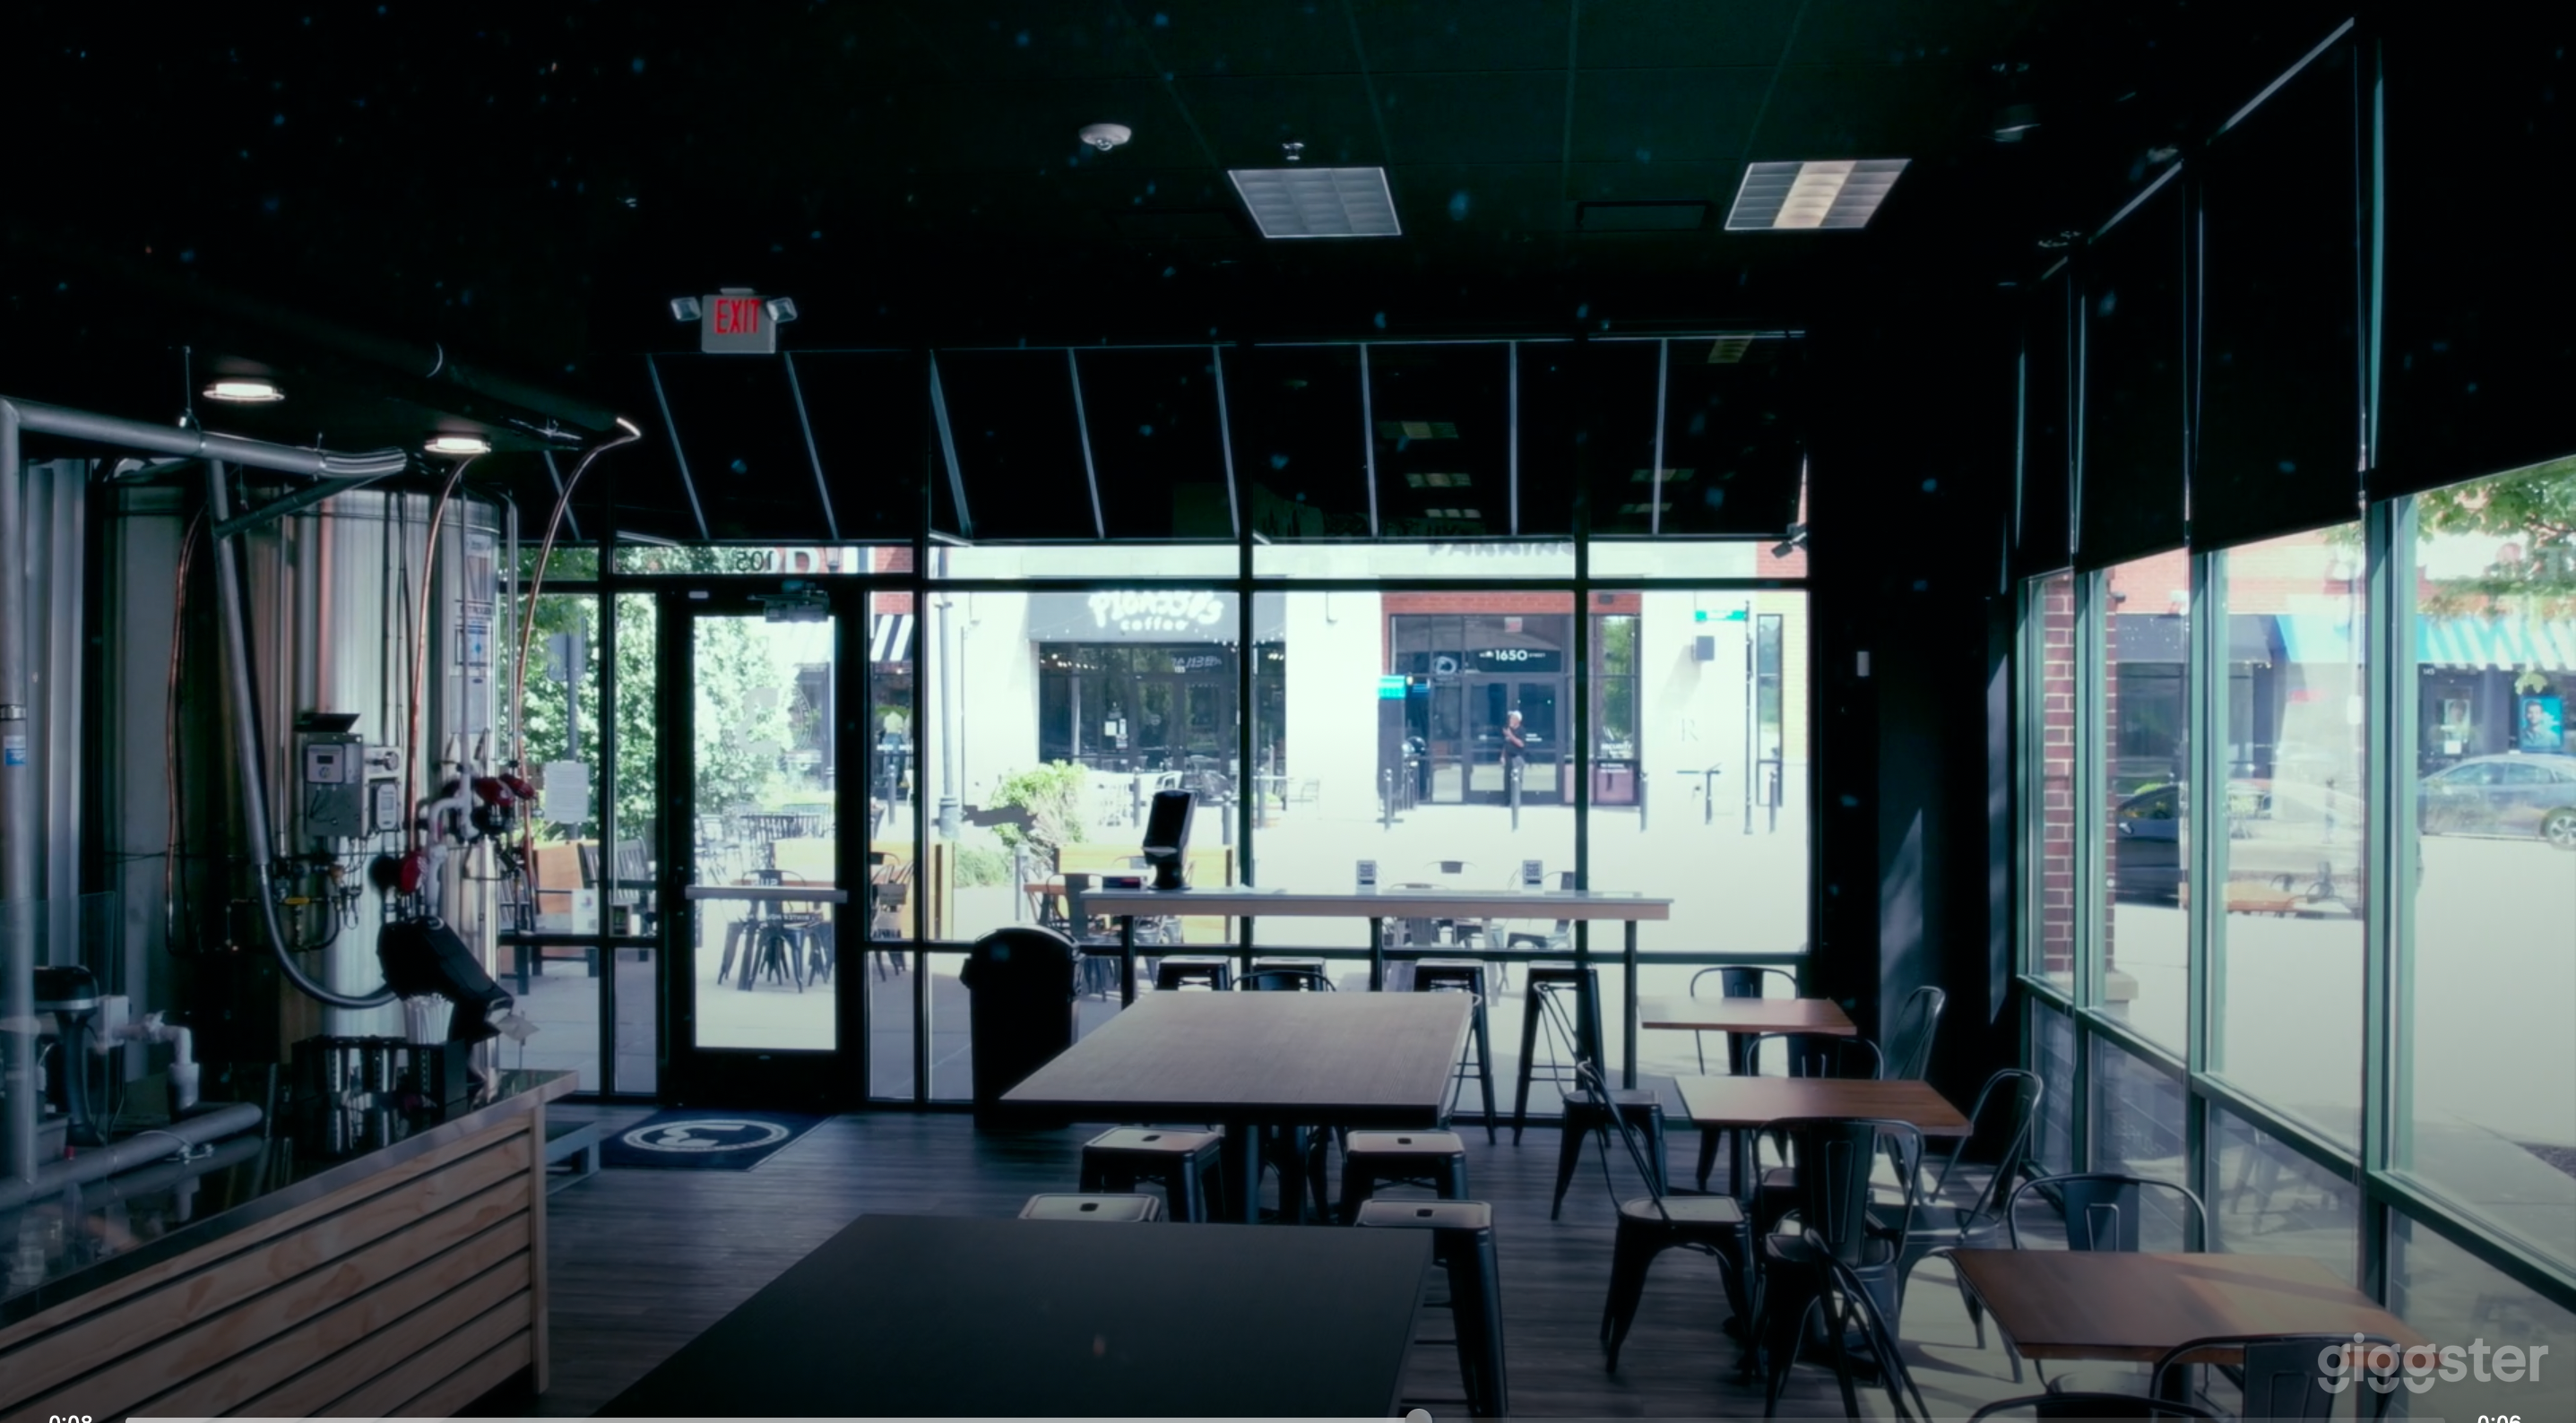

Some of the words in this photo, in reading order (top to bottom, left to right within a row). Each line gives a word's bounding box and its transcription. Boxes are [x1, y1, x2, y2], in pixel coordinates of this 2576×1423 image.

[714, 298, 760, 333] EXIT
[1120, 616, 1189, 631] coffee
[1495, 650, 1527, 661] 1650
